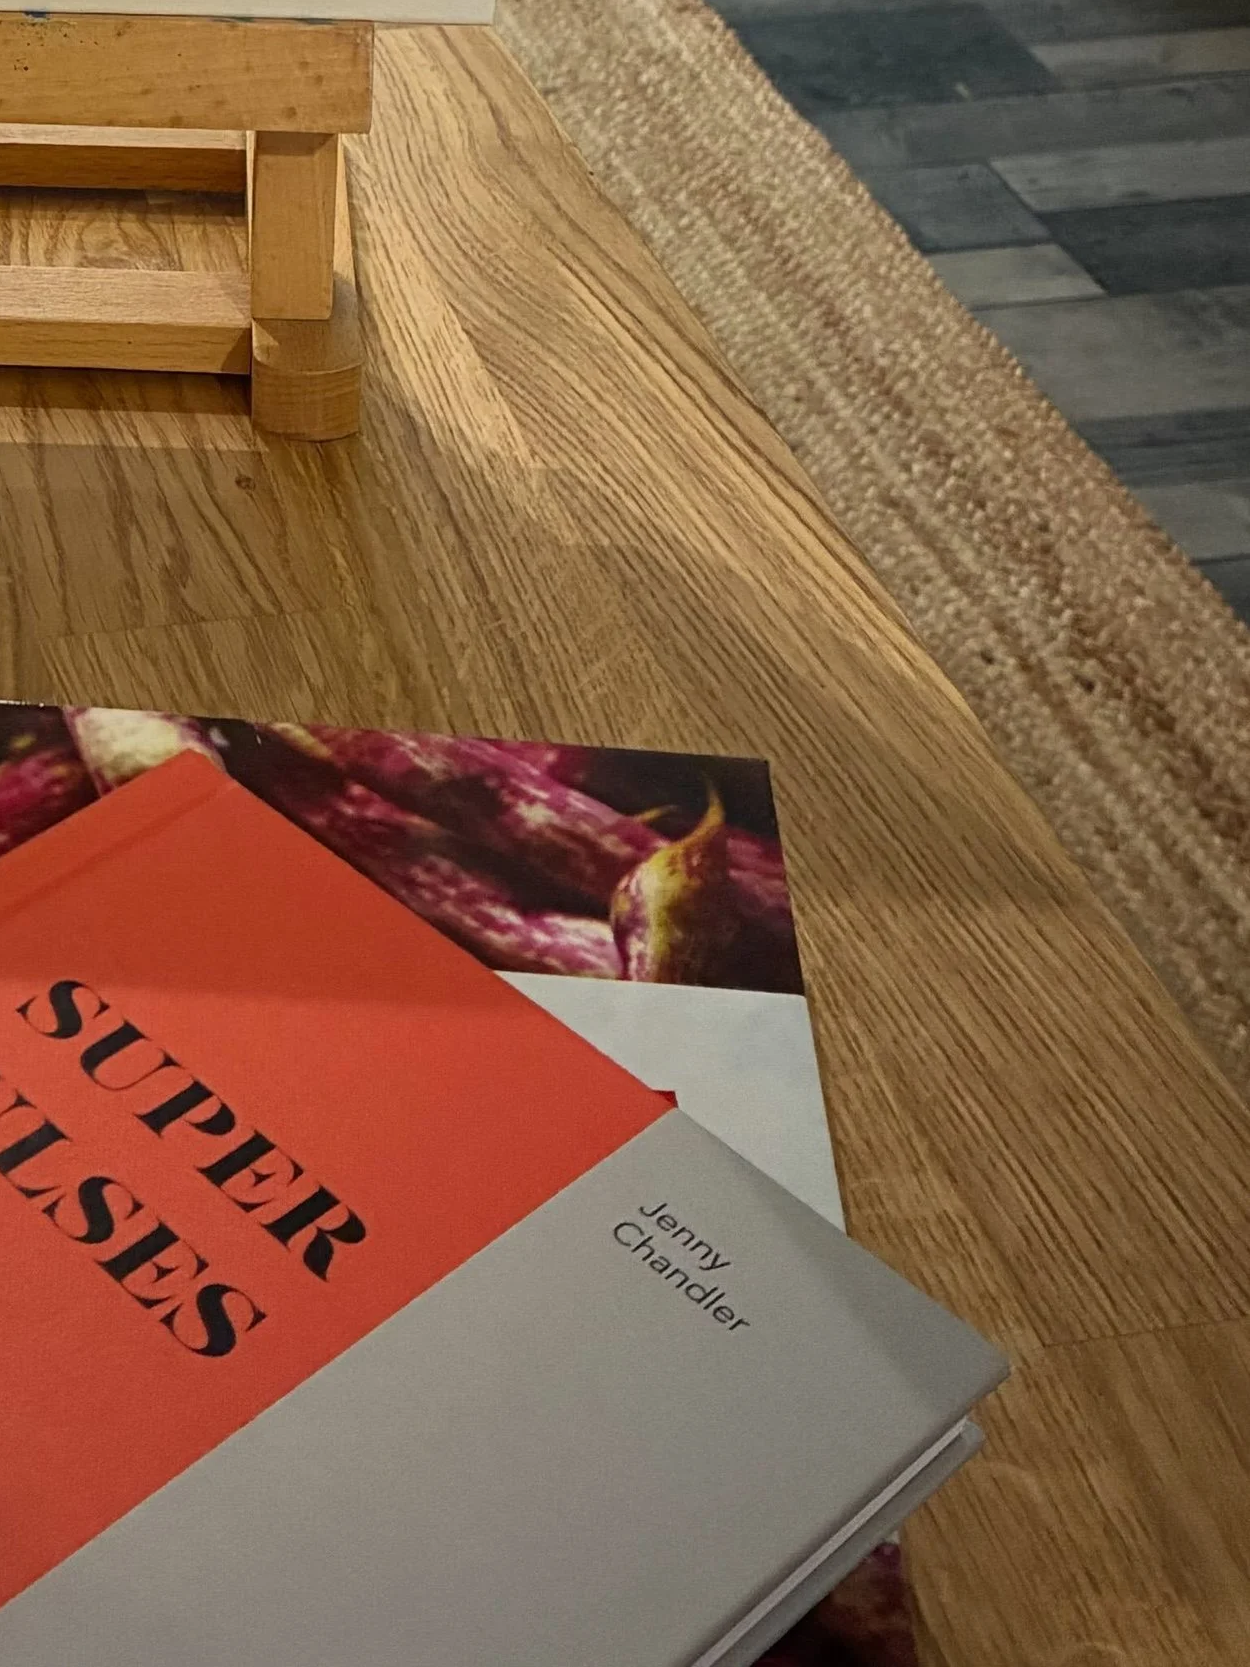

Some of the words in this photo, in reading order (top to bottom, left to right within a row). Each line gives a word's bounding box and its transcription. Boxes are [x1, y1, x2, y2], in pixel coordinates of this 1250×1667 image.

[15, 979, 367, 1283] SUPER
[613, 1221, 751, 1331] Chandler
[638, 1202, 732, 1272] Jenny
